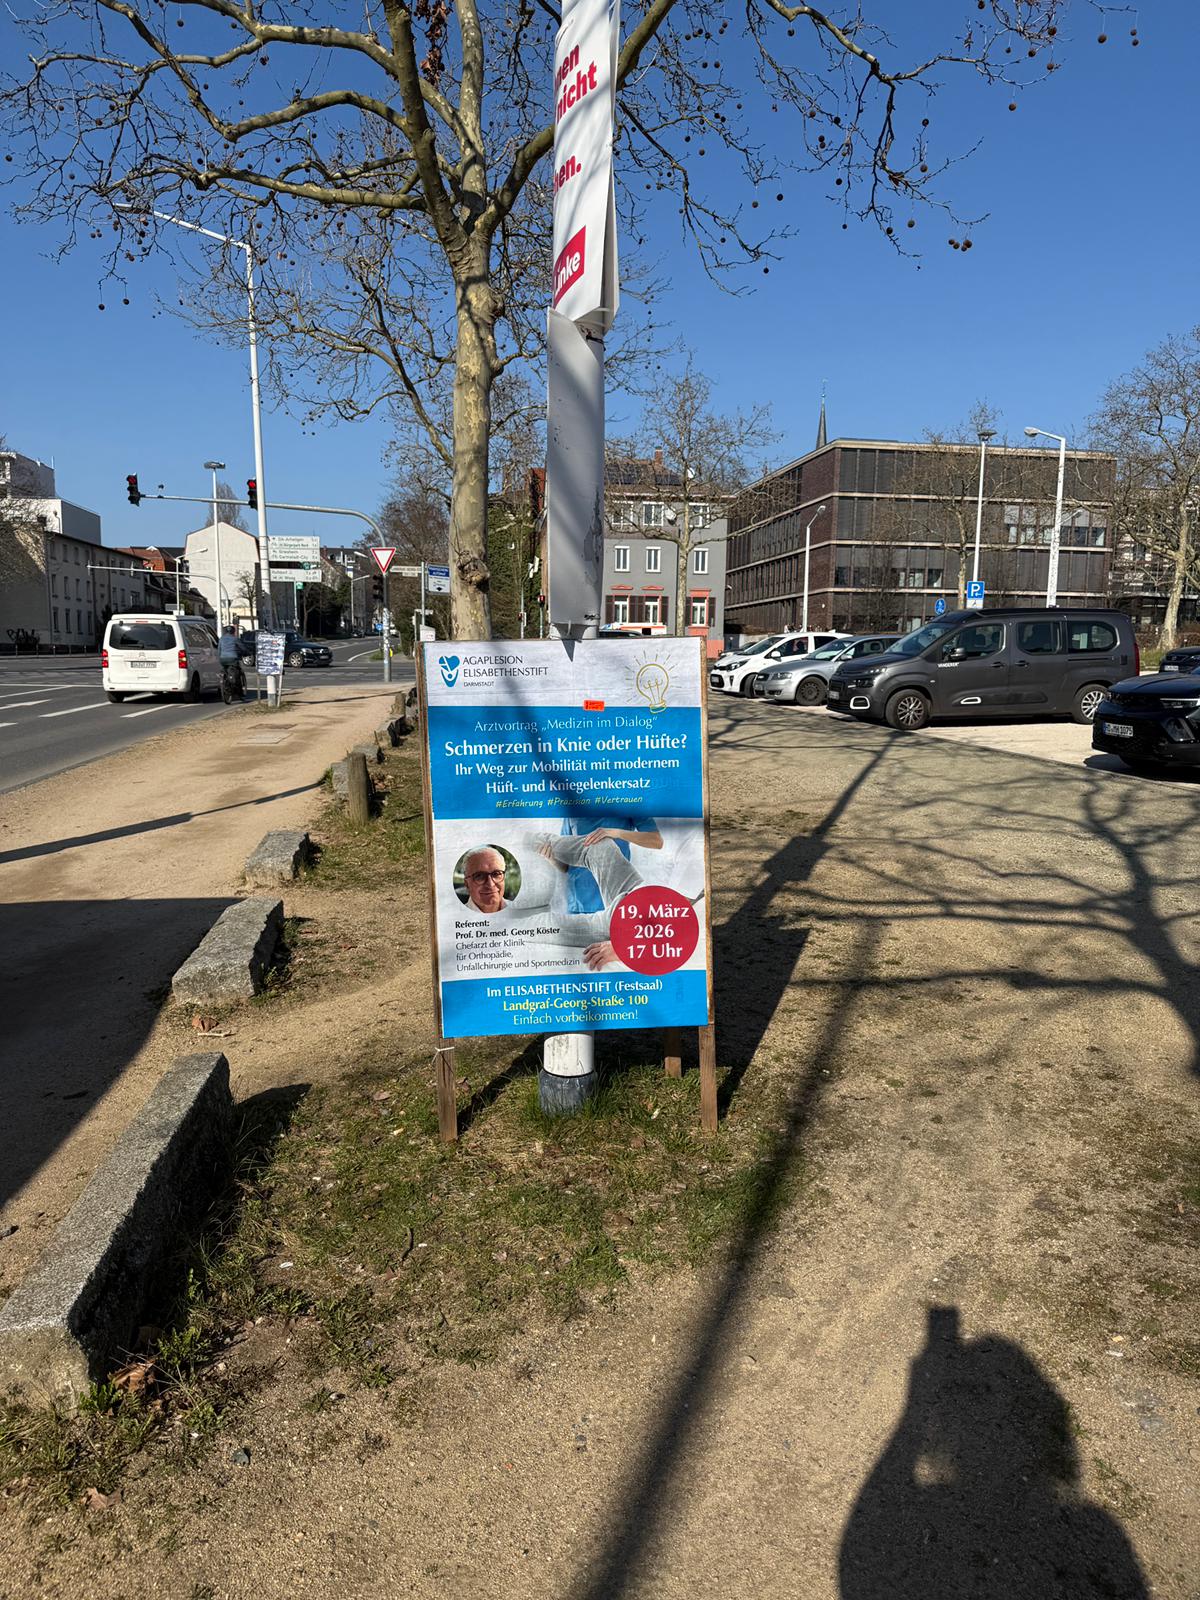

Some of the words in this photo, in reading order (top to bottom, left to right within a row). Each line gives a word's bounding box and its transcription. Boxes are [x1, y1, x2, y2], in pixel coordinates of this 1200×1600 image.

[557, 61, 597, 124] nicht
[970, 584, 980, 596] P
[462, 655, 523, 665] AGAPLESION
[463, 666, 548, 678] ELISABETHENSTIFT
[474, 720, 538, 732] Arztvortrag
[542, 718, 593, 731] „Medizin
[597, 718, 611, 728] im
[445, 740, 532, 756] Schmerzen
[538, 738, 552, 752] in
[558, 738, 591, 752] Knie
[598, 736, 631, 751] oder
[637, 734, 687, 750] Hüfte?
[456, 764, 472, 776] Ihr
[476, 762, 504, 778] Weg
[508, 763, 528, 774] zur
[532, 760, 586, 773] Mobilität
[590, 759, 610, 771] mit
[614, 758, 680, 770] modernem
[486, 780, 518, 793] Hüft-
[522, 780, 545, 792] und
[550, 777, 650, 794] Kniegelenkersatz
[496, 799, 544, 809] #Erfahrung
[595, 796, 643, 806] #Vertrauen
[618, 905, 642, 919] 19.
[648, 904, 689, 918] März
[455, 920, 490, 930] Referent:
[634, 924, 674, 939] 2026
[455, 931, 472, 940] Prof.
[476, 930, 488, 938] Dr.
[489, 929, 508, 938] med.
[510, 927, 535, 938] Georg
[536, 926, 560, 936] Köster
[456, 941, 488, 950] Chefarzt
[489, 940, 502, 948] der
[504, 938, 526, 948] Klinik
[628, 944, 646, 959] 17
[652, 944, 682, 958] Uhr
[456, 952, 467, 962] für
[468, 950, 514, 961] Orthopädie,
[456, 960, 513, 972] Unfallchirurgie
[514, 959, 529, 968] und
[531, 957, 580, 968] Sportmedizin
[487, 988, 502, 998] Im
[504, 982, 610, 997] ELISABETHENSTIFT
[615, 980, 663, 993] (Festsaal)
[503, 996, 624, 1013] Landgraf-Georg-Straße
[628, 995, 648, 1006] 100
[513, 1014, 552, 1026] Einfach
[555, 1010, 638, 1024] vorbeikommen!
